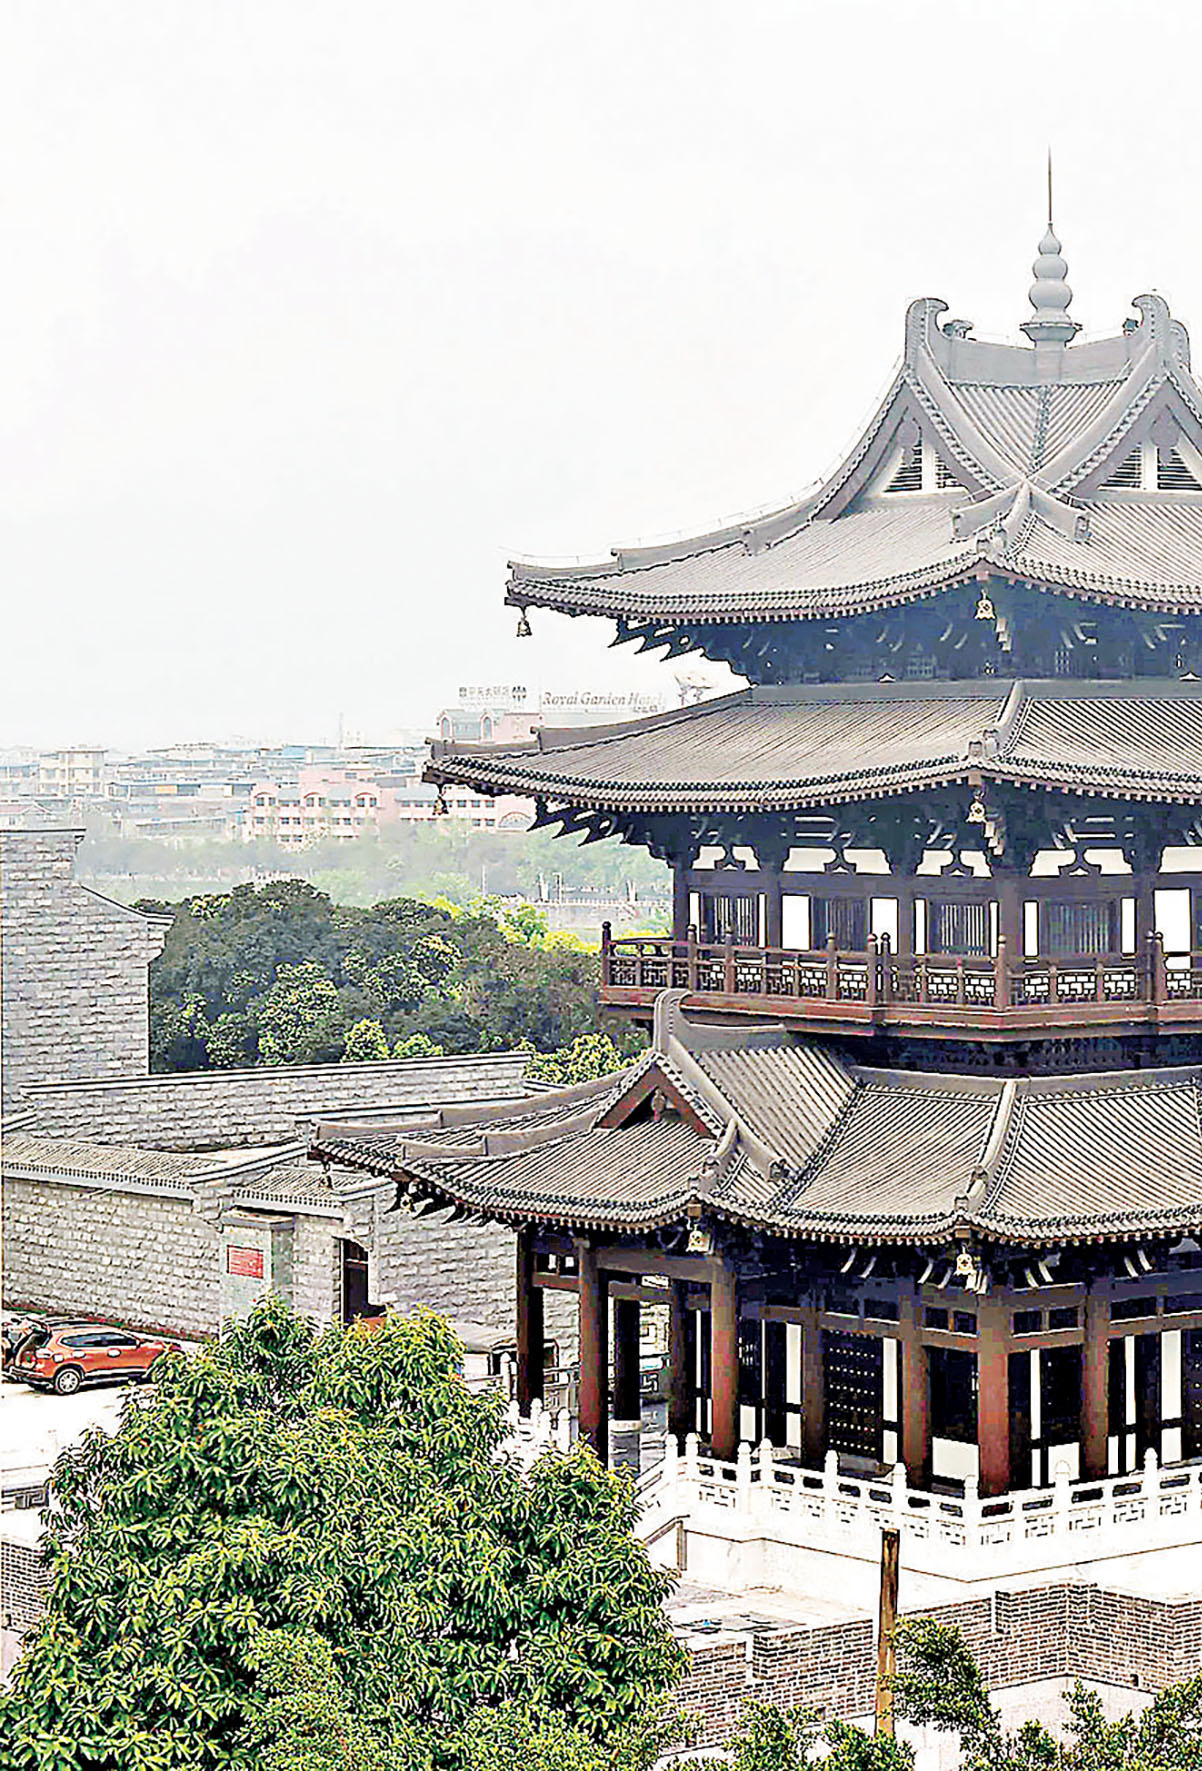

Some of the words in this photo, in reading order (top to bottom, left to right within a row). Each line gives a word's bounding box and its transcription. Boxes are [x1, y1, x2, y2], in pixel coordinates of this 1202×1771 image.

[542, 690, 578, 706] Royal
[580, 690, 626, 705] Garden
[628, 691, 663, 705] Hotel
